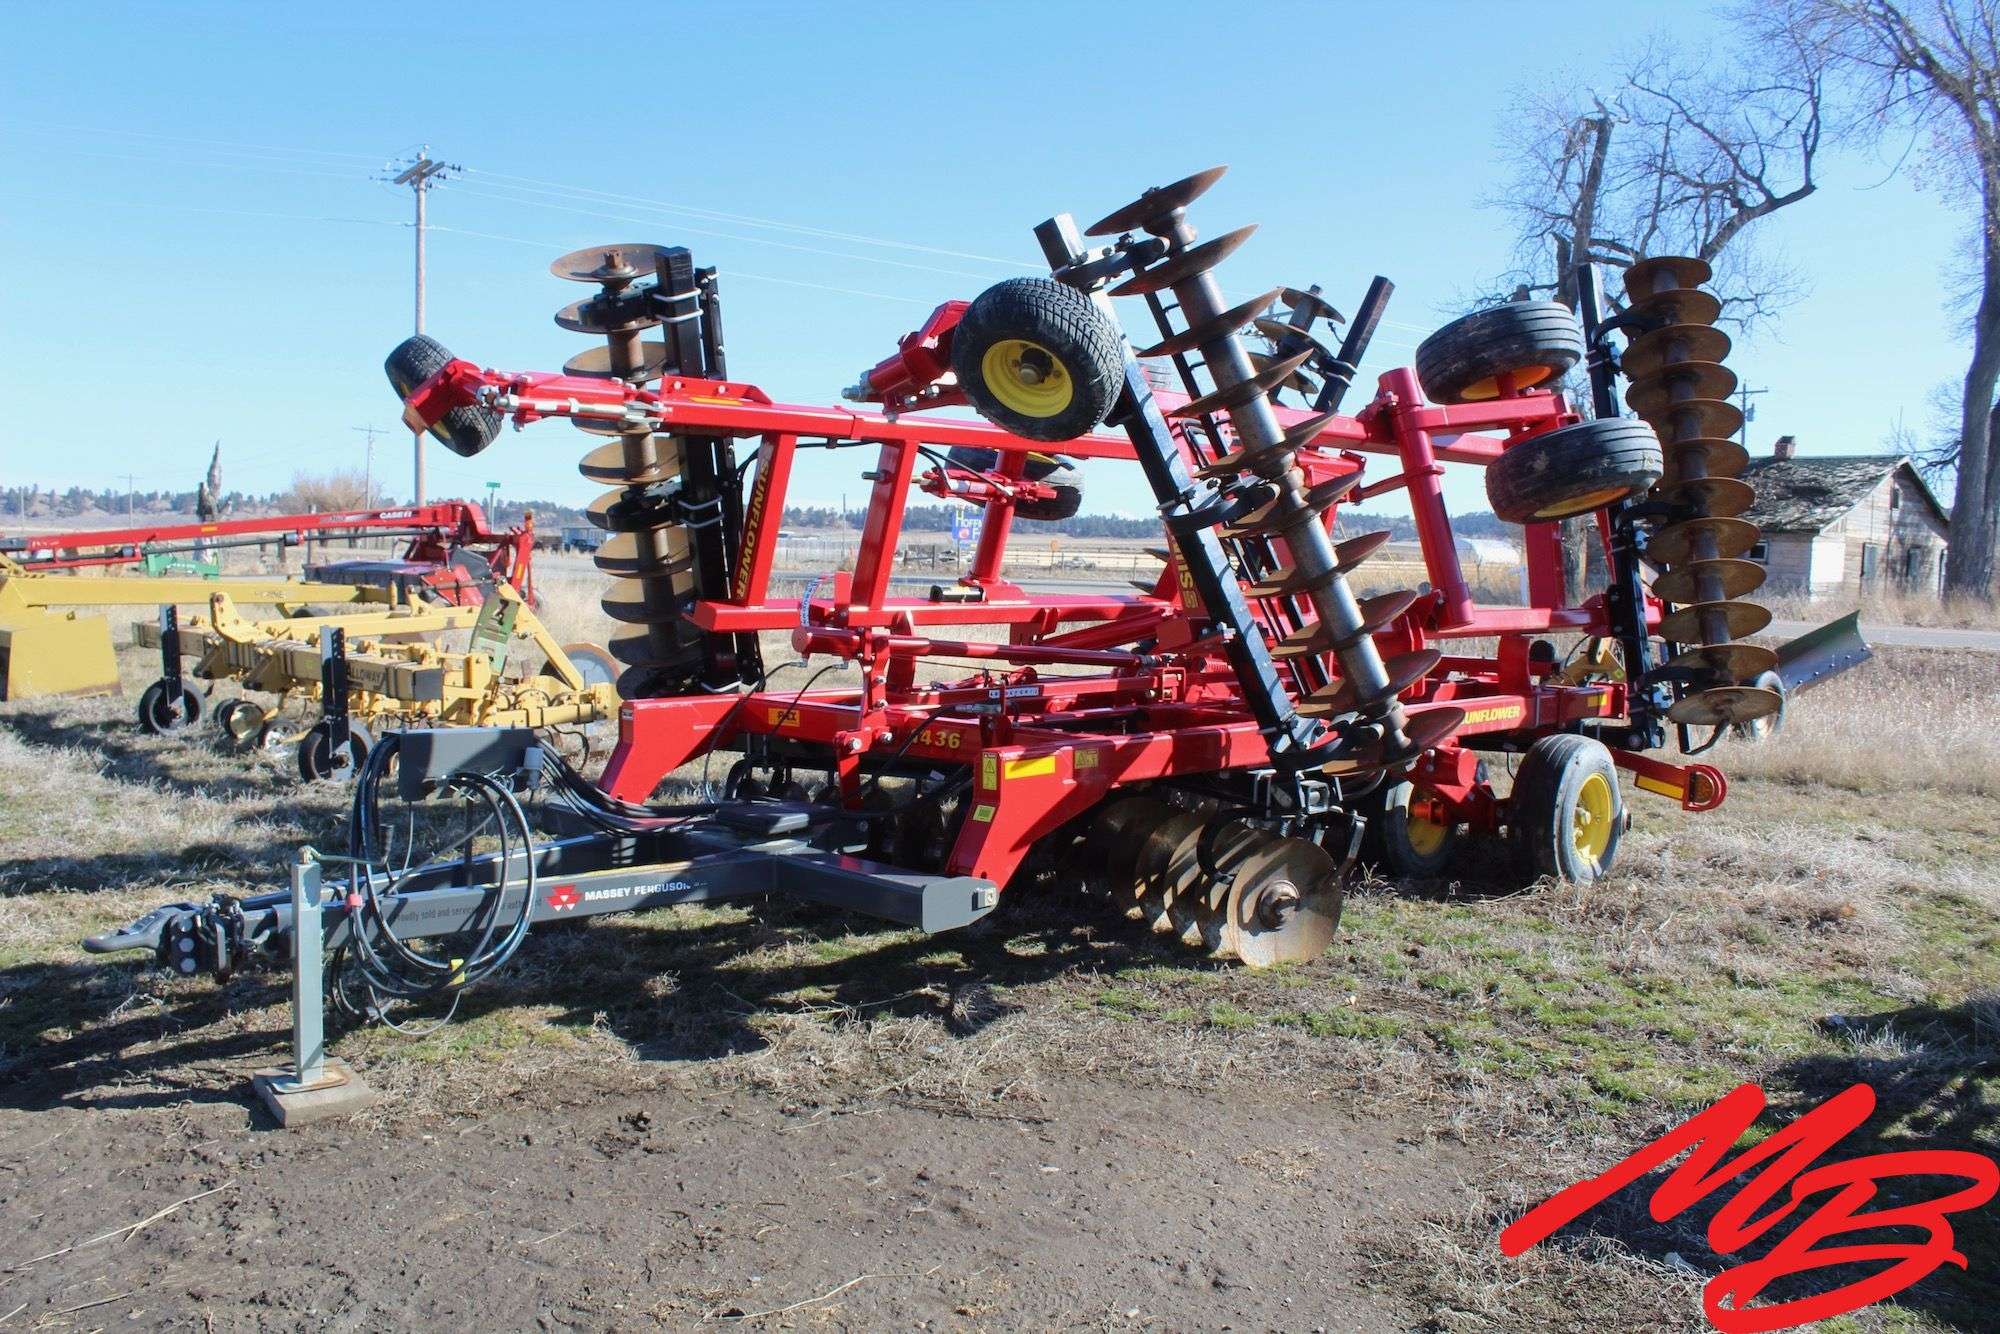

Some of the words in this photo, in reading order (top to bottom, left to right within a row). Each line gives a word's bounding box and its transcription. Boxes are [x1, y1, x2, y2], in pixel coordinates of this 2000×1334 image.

[736, 461, 769, 598] SUNFLOWER
[1462, 705, 1521, 725] UNFLOWER
[584, 887, 631, 901] MASSEY
